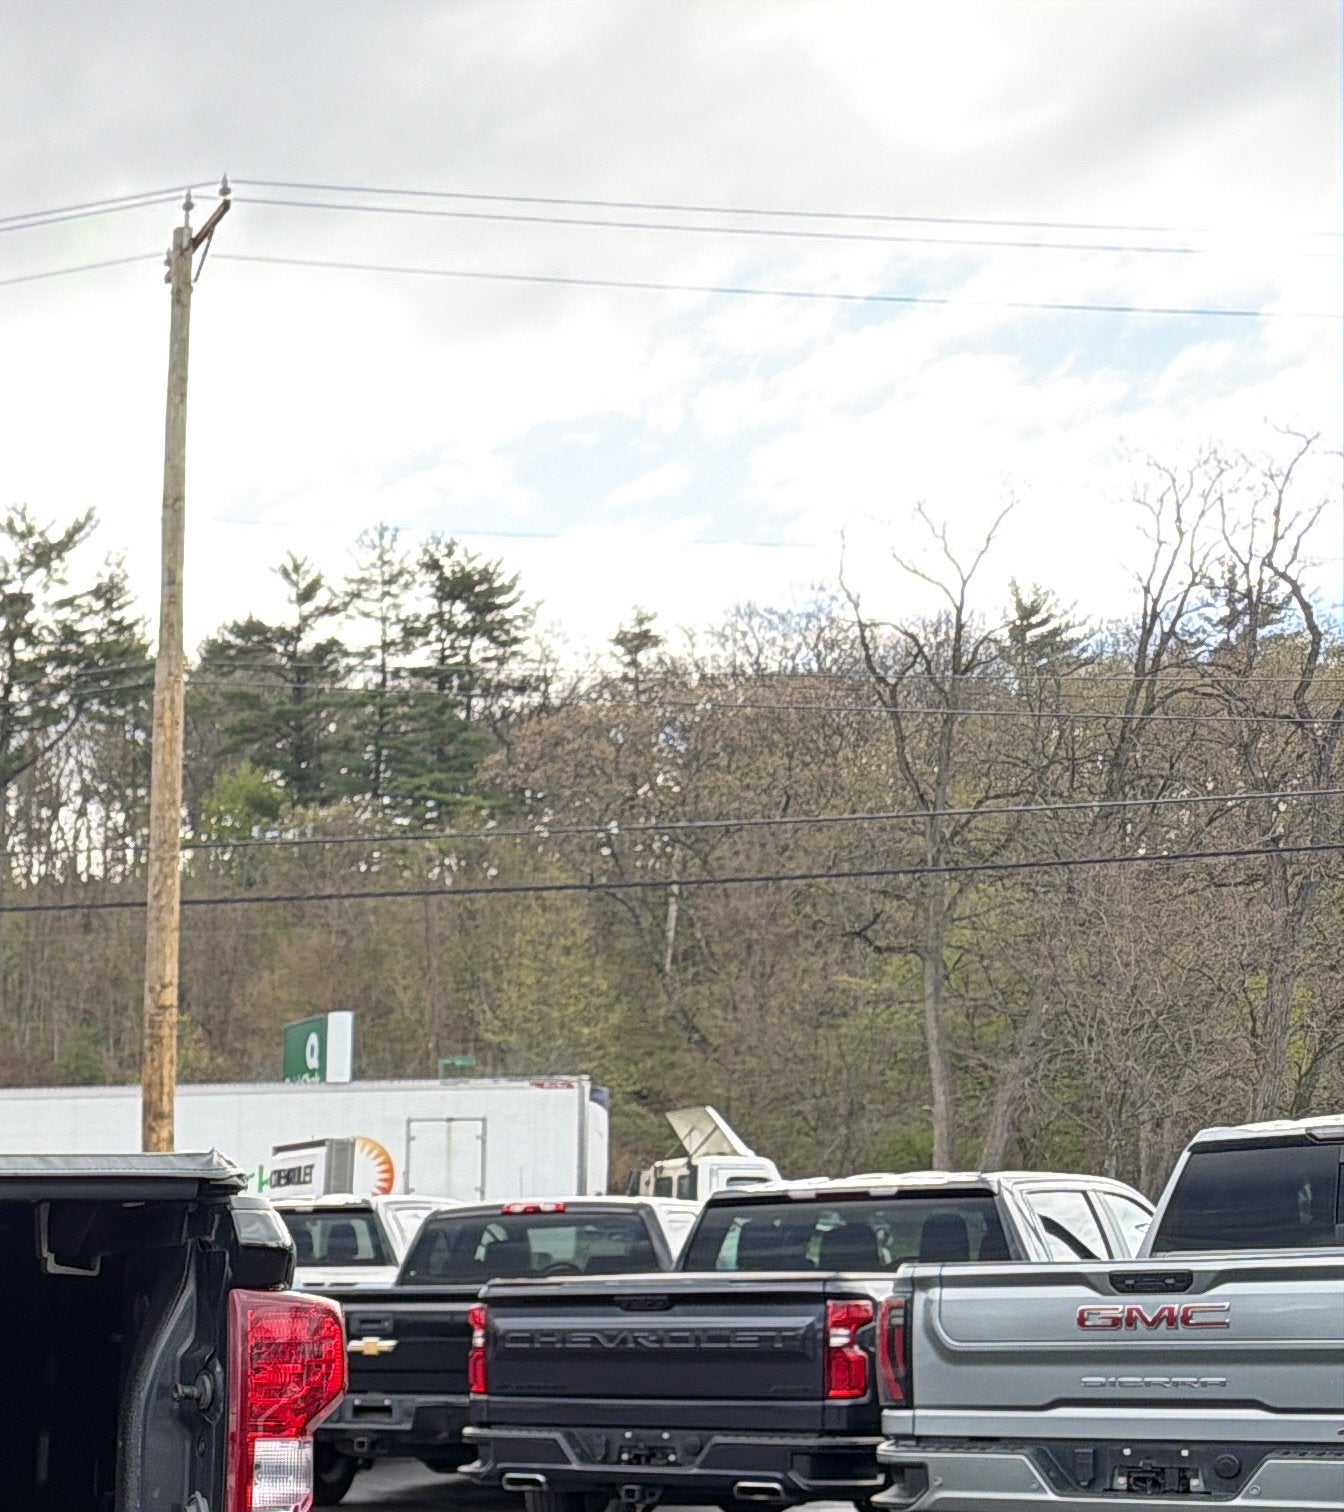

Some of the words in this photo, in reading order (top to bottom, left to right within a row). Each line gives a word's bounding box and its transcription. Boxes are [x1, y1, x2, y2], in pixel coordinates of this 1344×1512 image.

[1076, 1302, 1231, 1331] GMC
[504, 1329, 802, 1349] CHEVROLET
[1080, 1376, 1228, 1388] SIERRA
